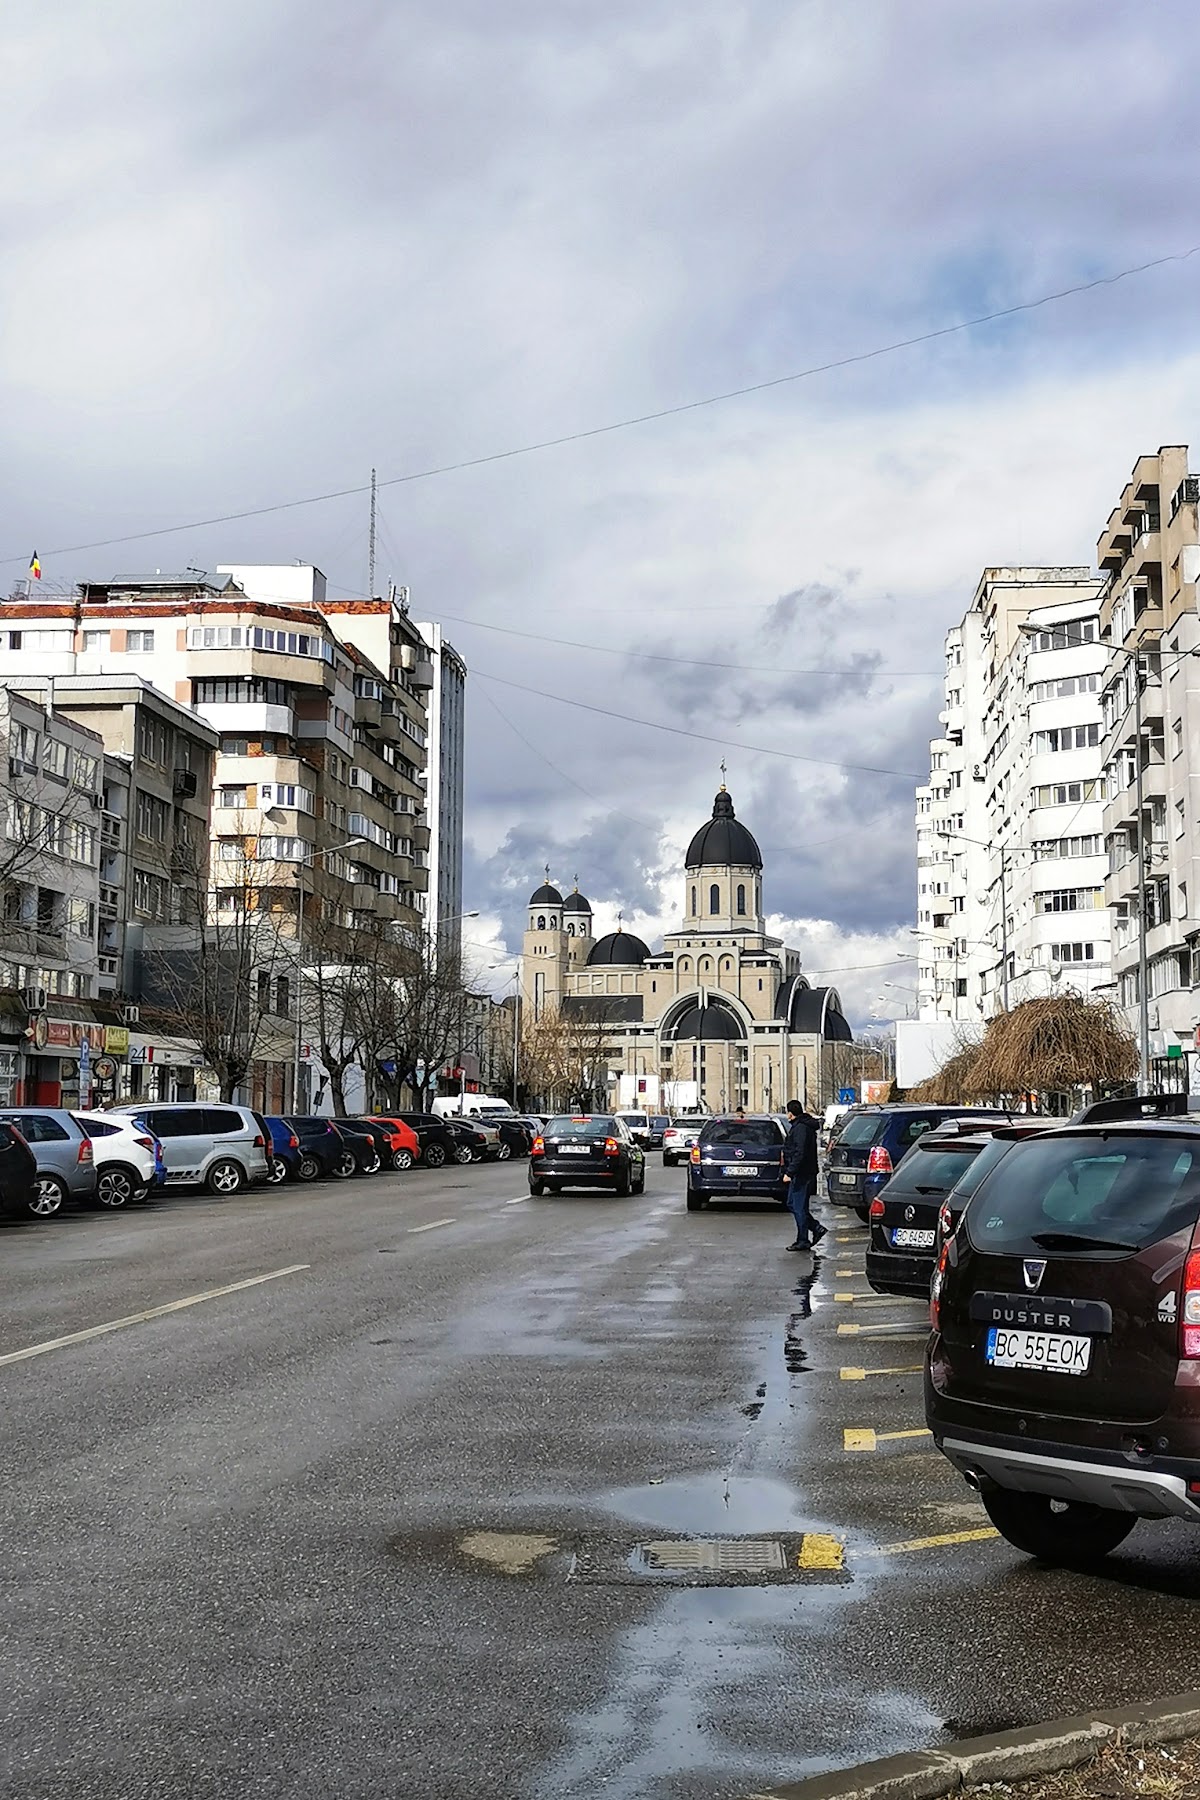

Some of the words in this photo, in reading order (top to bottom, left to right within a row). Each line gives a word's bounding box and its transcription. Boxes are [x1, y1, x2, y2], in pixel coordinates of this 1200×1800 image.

[82, 1041, 89, 1059] P
[130, 1045, 148, 1063] 24
[896, 1229, 908, 1242] BC
[909, 1230, 934, 1244] 64BUS
[1158, 1290, 1177, 1313] 4
[992, 1308, 1071, 1328] DUSTER
[1158, 1314, 1176, 1324] WD
[995, 1332, 1019, 1358] BC
[1024, 1335, 1088, 1367] 55EOK
